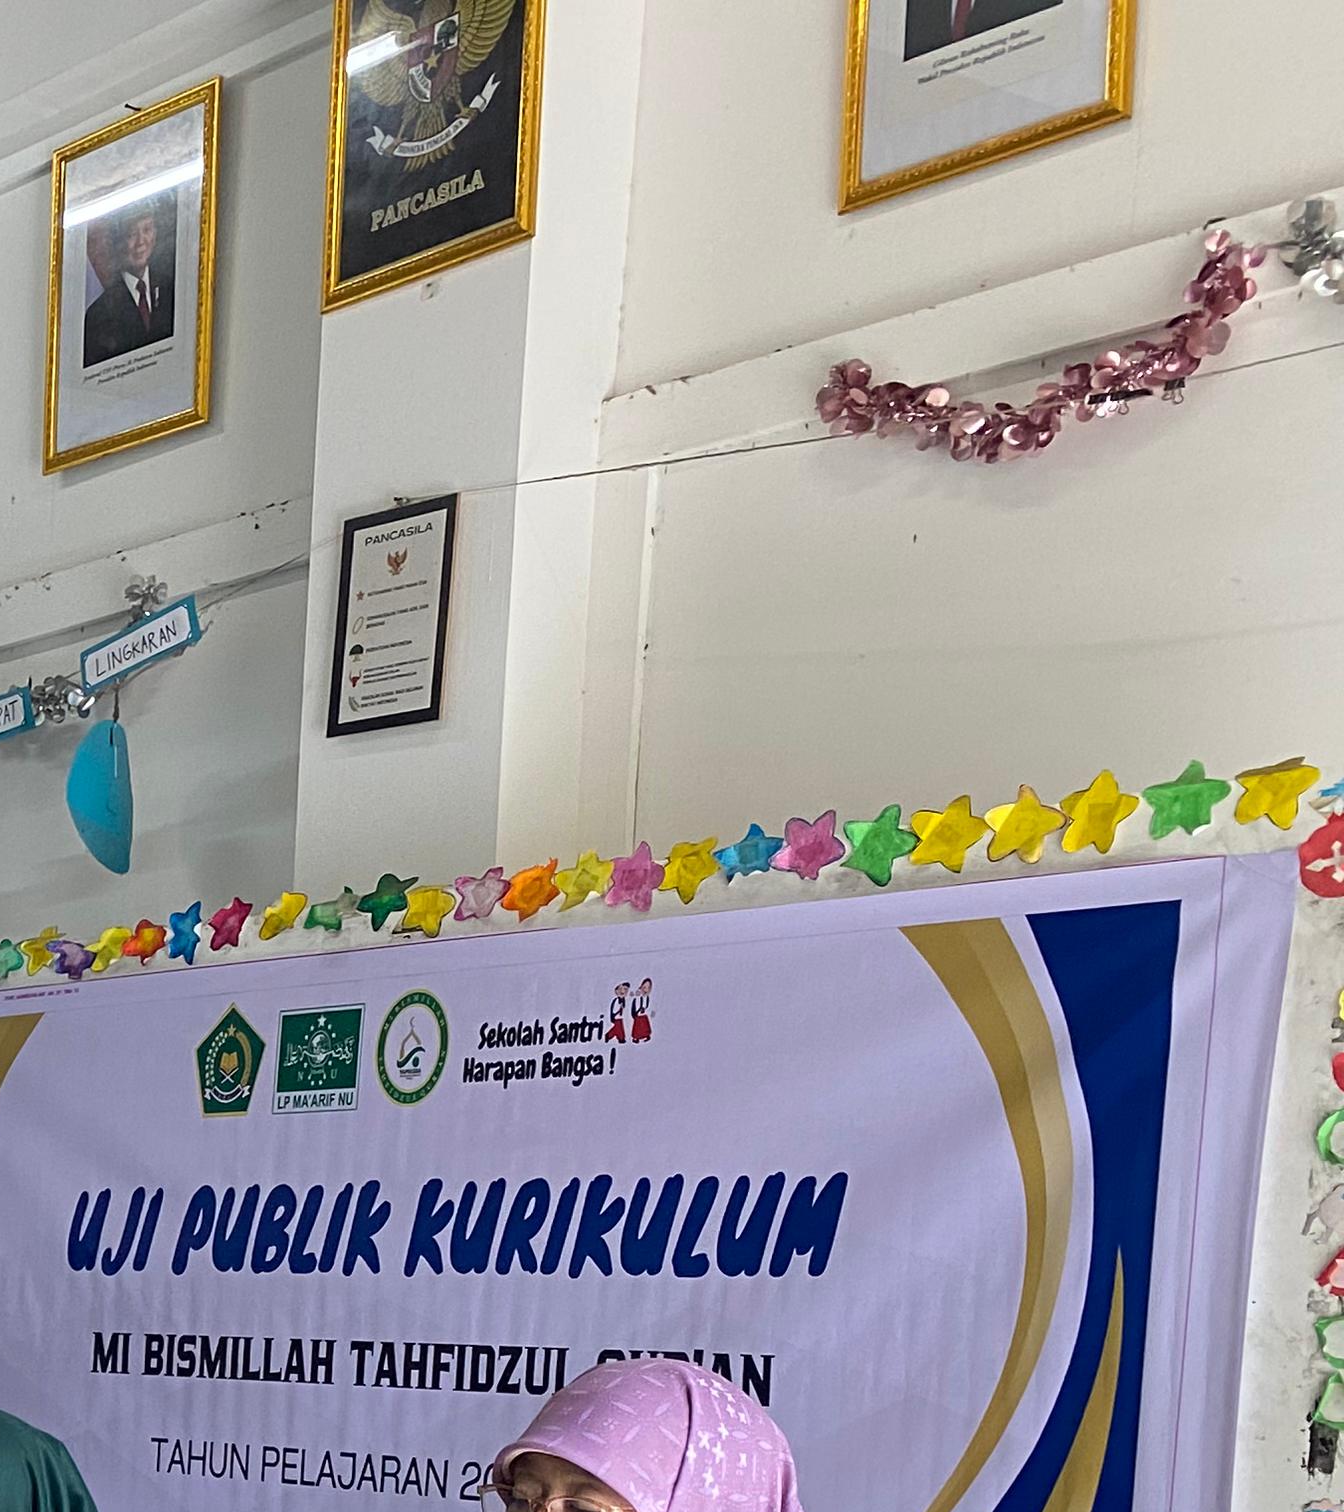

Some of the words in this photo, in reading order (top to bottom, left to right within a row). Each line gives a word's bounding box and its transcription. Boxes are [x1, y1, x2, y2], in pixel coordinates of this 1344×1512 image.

[370, 168, 486, 232] PANCASILA
[364, 521, 434, 547] PANCASILA
[94, 620, 179, 678] LINGKARAN
[477, 1018, 545, 1051] Sekolah
[550, 1014, 605, 1044] Santri
[462, 1051, 537, 1089] Harapan
[541, 1050, 605, 1088] Bangsa
[277, 1095, 291, 1110] LP
[292, 1092, 336, 1109] MA'ARIF
[338, 1091, 354, 1106] NU
[67, 1187, 164, 1276] UJI
[171, 1179, 393, 1277] PUBLIK
[403, 1171, 849, 1278] KURIKULUM
[91, 1331, 132, 1375] MI
[141, 1332, 337, 1386] BISMILLAH
[150, 1437, 251, 1481] TAHUN
[260, 1446, 449, 1498] PELAJARAN
